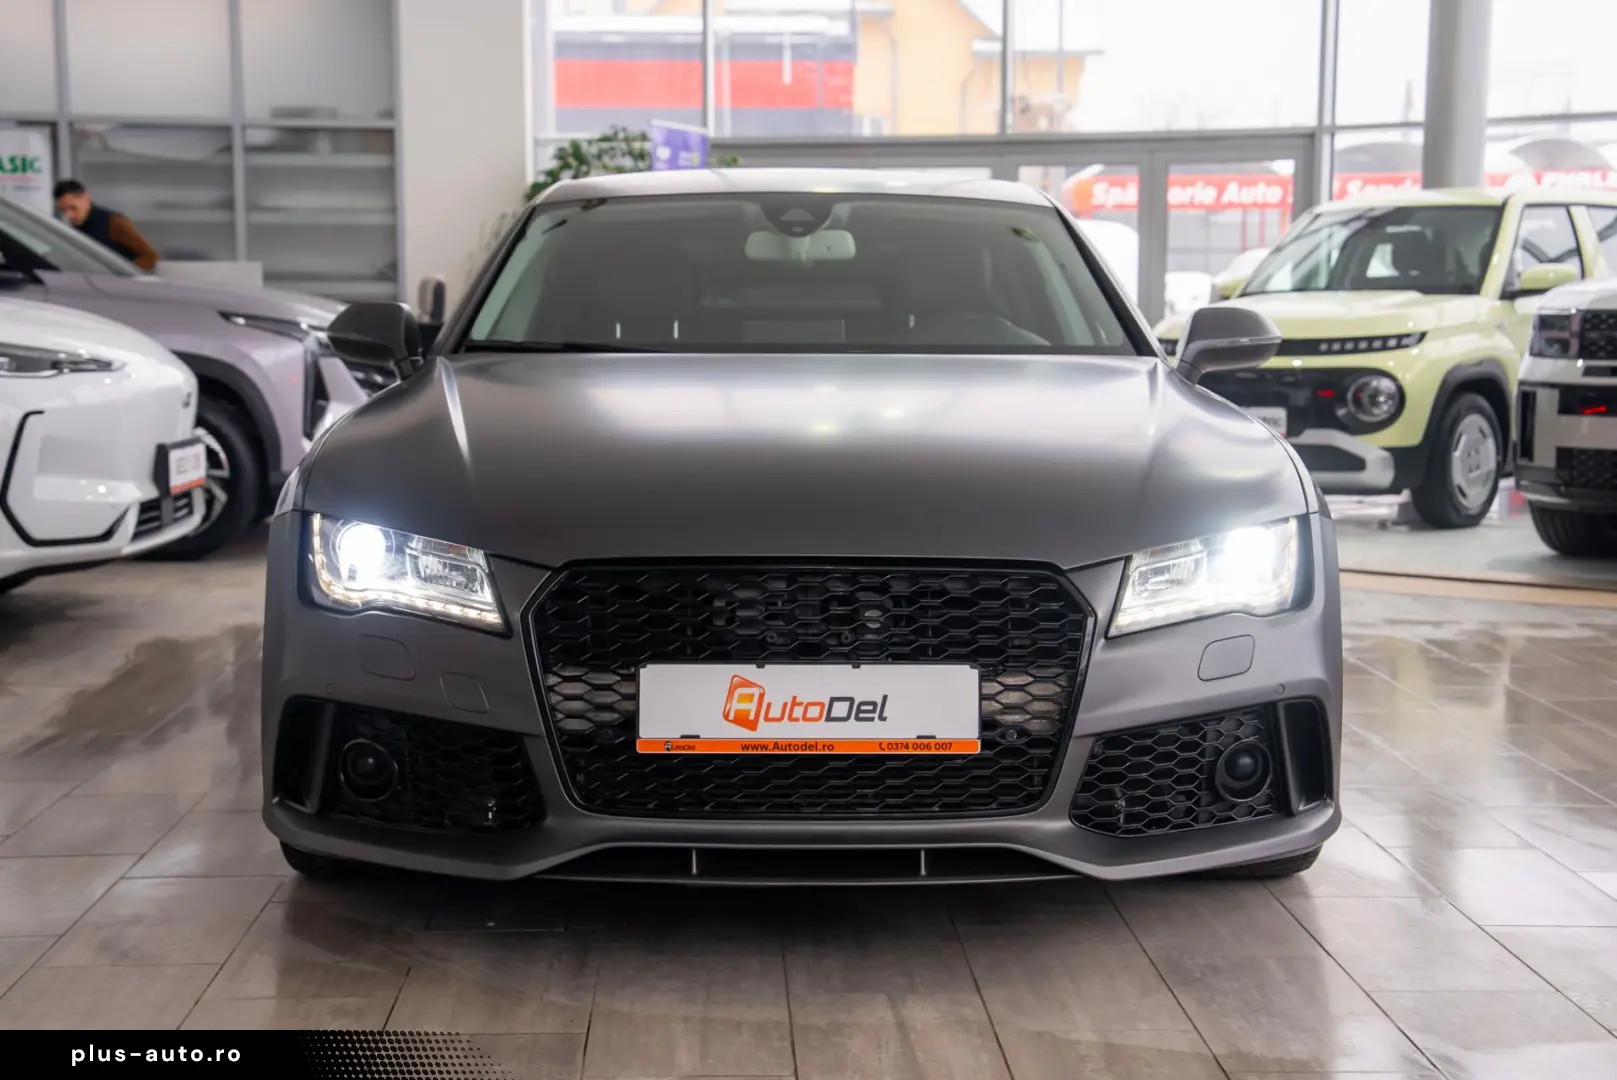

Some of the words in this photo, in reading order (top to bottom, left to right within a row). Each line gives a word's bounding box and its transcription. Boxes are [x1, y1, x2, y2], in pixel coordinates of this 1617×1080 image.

[1221, 181, 1283, 204] Auto
[726, 681, 888, 726] AutoDel
[740, 741, 835, 752] www.Autodel.ro
[887, 742, 909, 751] 0374
[912, 742, 932, 751] 006
[934, 742, 953, 751] 007
